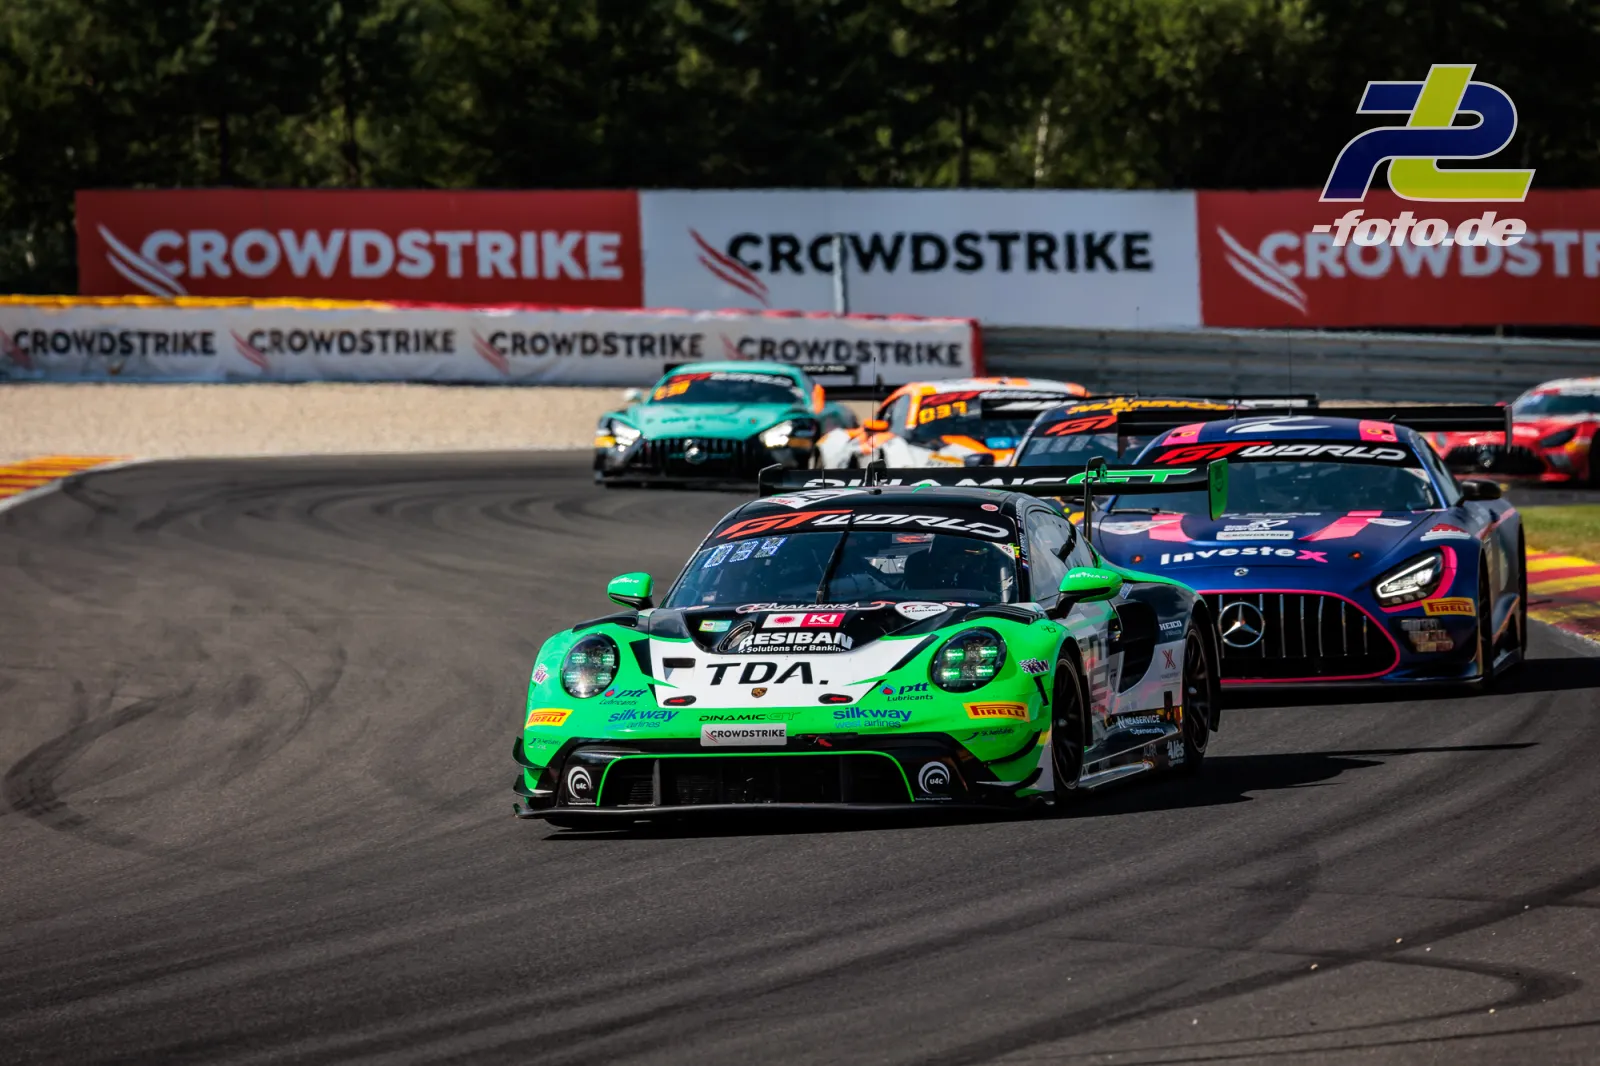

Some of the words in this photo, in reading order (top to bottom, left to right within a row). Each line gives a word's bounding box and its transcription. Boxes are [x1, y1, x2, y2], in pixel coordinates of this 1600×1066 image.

[140, 228, 624, 279] CROWDSTRIKE
[727, 231, 1153, 274] CROWDSTRIKE
[13, 328, 216, 356] CROWDSTRIKE
[247, 328, 455, 356] CROWDSTRIKE
[487, 331, 703, 358] CROWDSTRIKE
[737, 336, 962, 367] CROWDSTRIKE
[1237, 445, 1406, 461] WORLD
[811, 513, 1009, 538] WORLD
[1160, 546, 1329, 566] Investex
[1428, 600, 1472, 613] PIRELLI
[809, 614, 838, 623] KI
[887, 693, 934, 702] Lubricants
[528, 712, 567, 724] PIRELLI
[970, 704, 1026, 717] PIRELLI
[863, 720, 901, 728] airlines
[710, 729, 785, 738] CROWDSTRIKE
